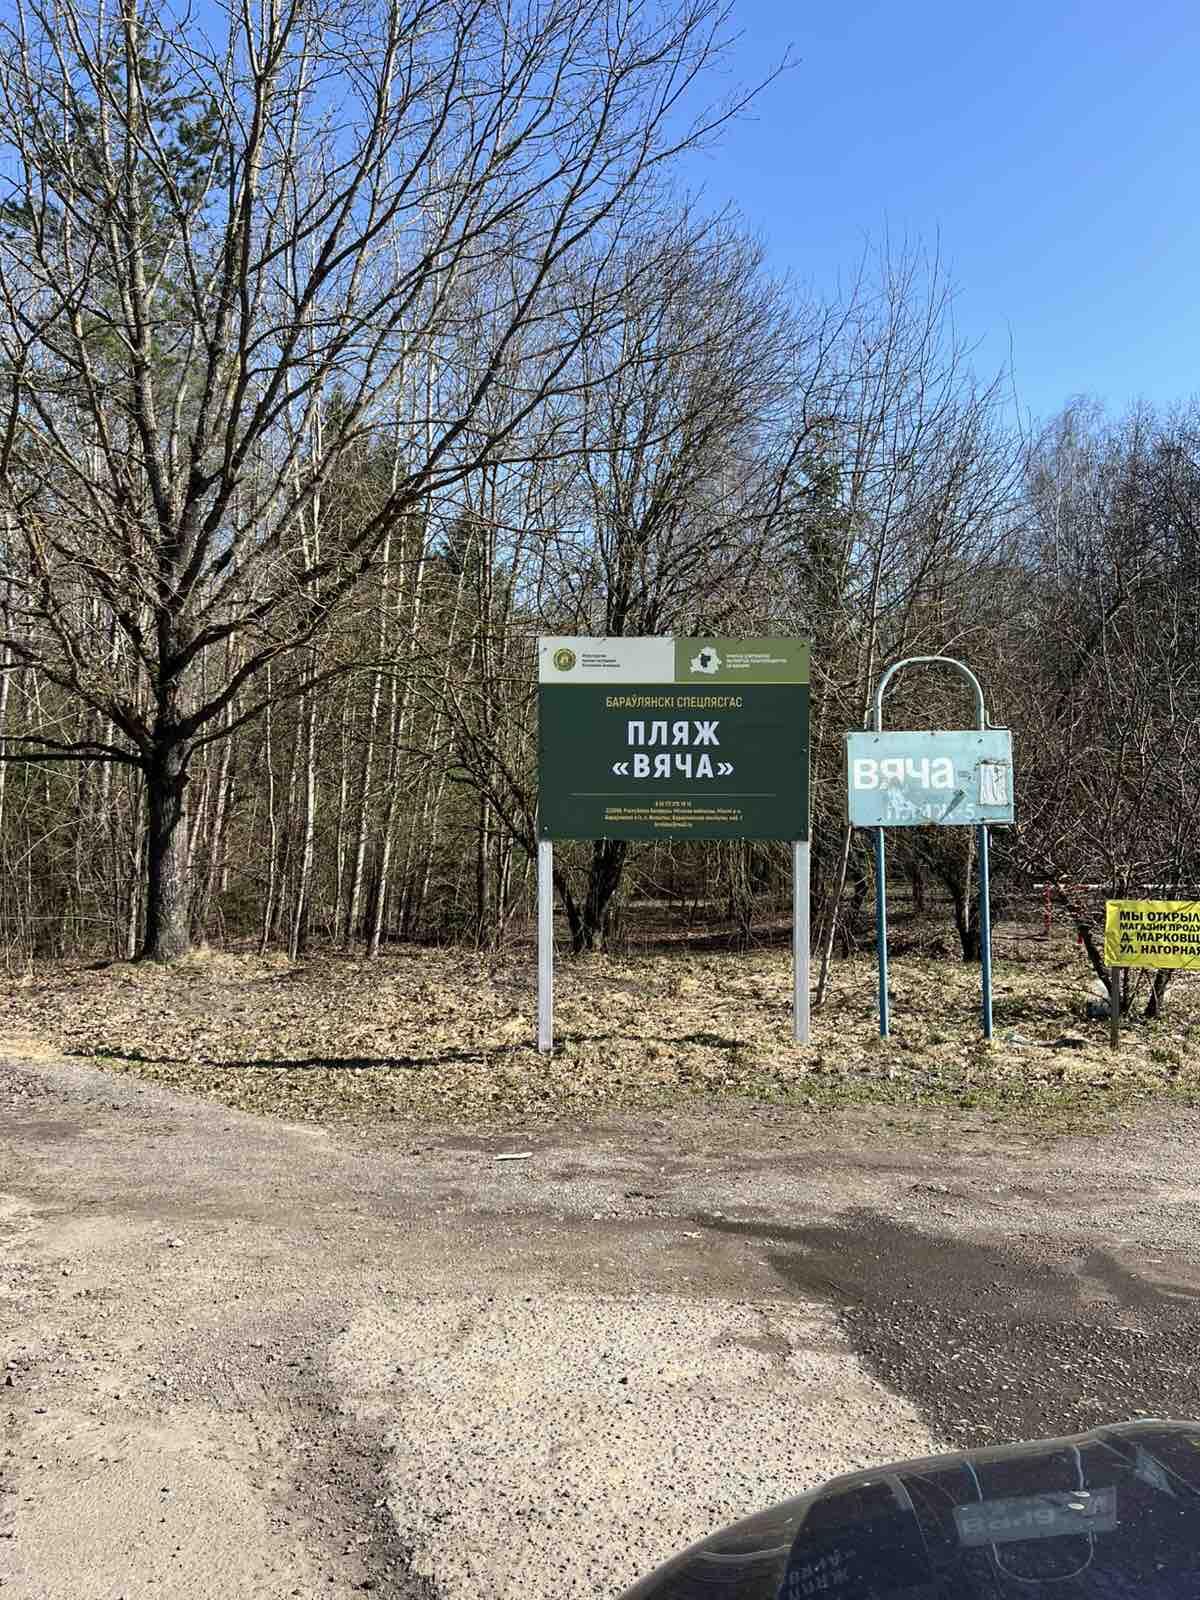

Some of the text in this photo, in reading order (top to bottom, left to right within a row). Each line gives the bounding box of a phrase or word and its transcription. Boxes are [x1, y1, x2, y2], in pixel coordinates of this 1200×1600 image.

[606, 694, 743, 709] БАРАЎЛЯНСКІ СПЕЦЛЯСГАС
[627, 720, 720, 746] ПЛЯЖ
[612, 753, 734, 778] «ВЯЧА»
[1120, 911, 1200, 922] МЫ ОТКРЫЛ
[1120, 922, 1166, 931] МАГАЗИН
[1120, 943, 1137, 954] УЛ.
